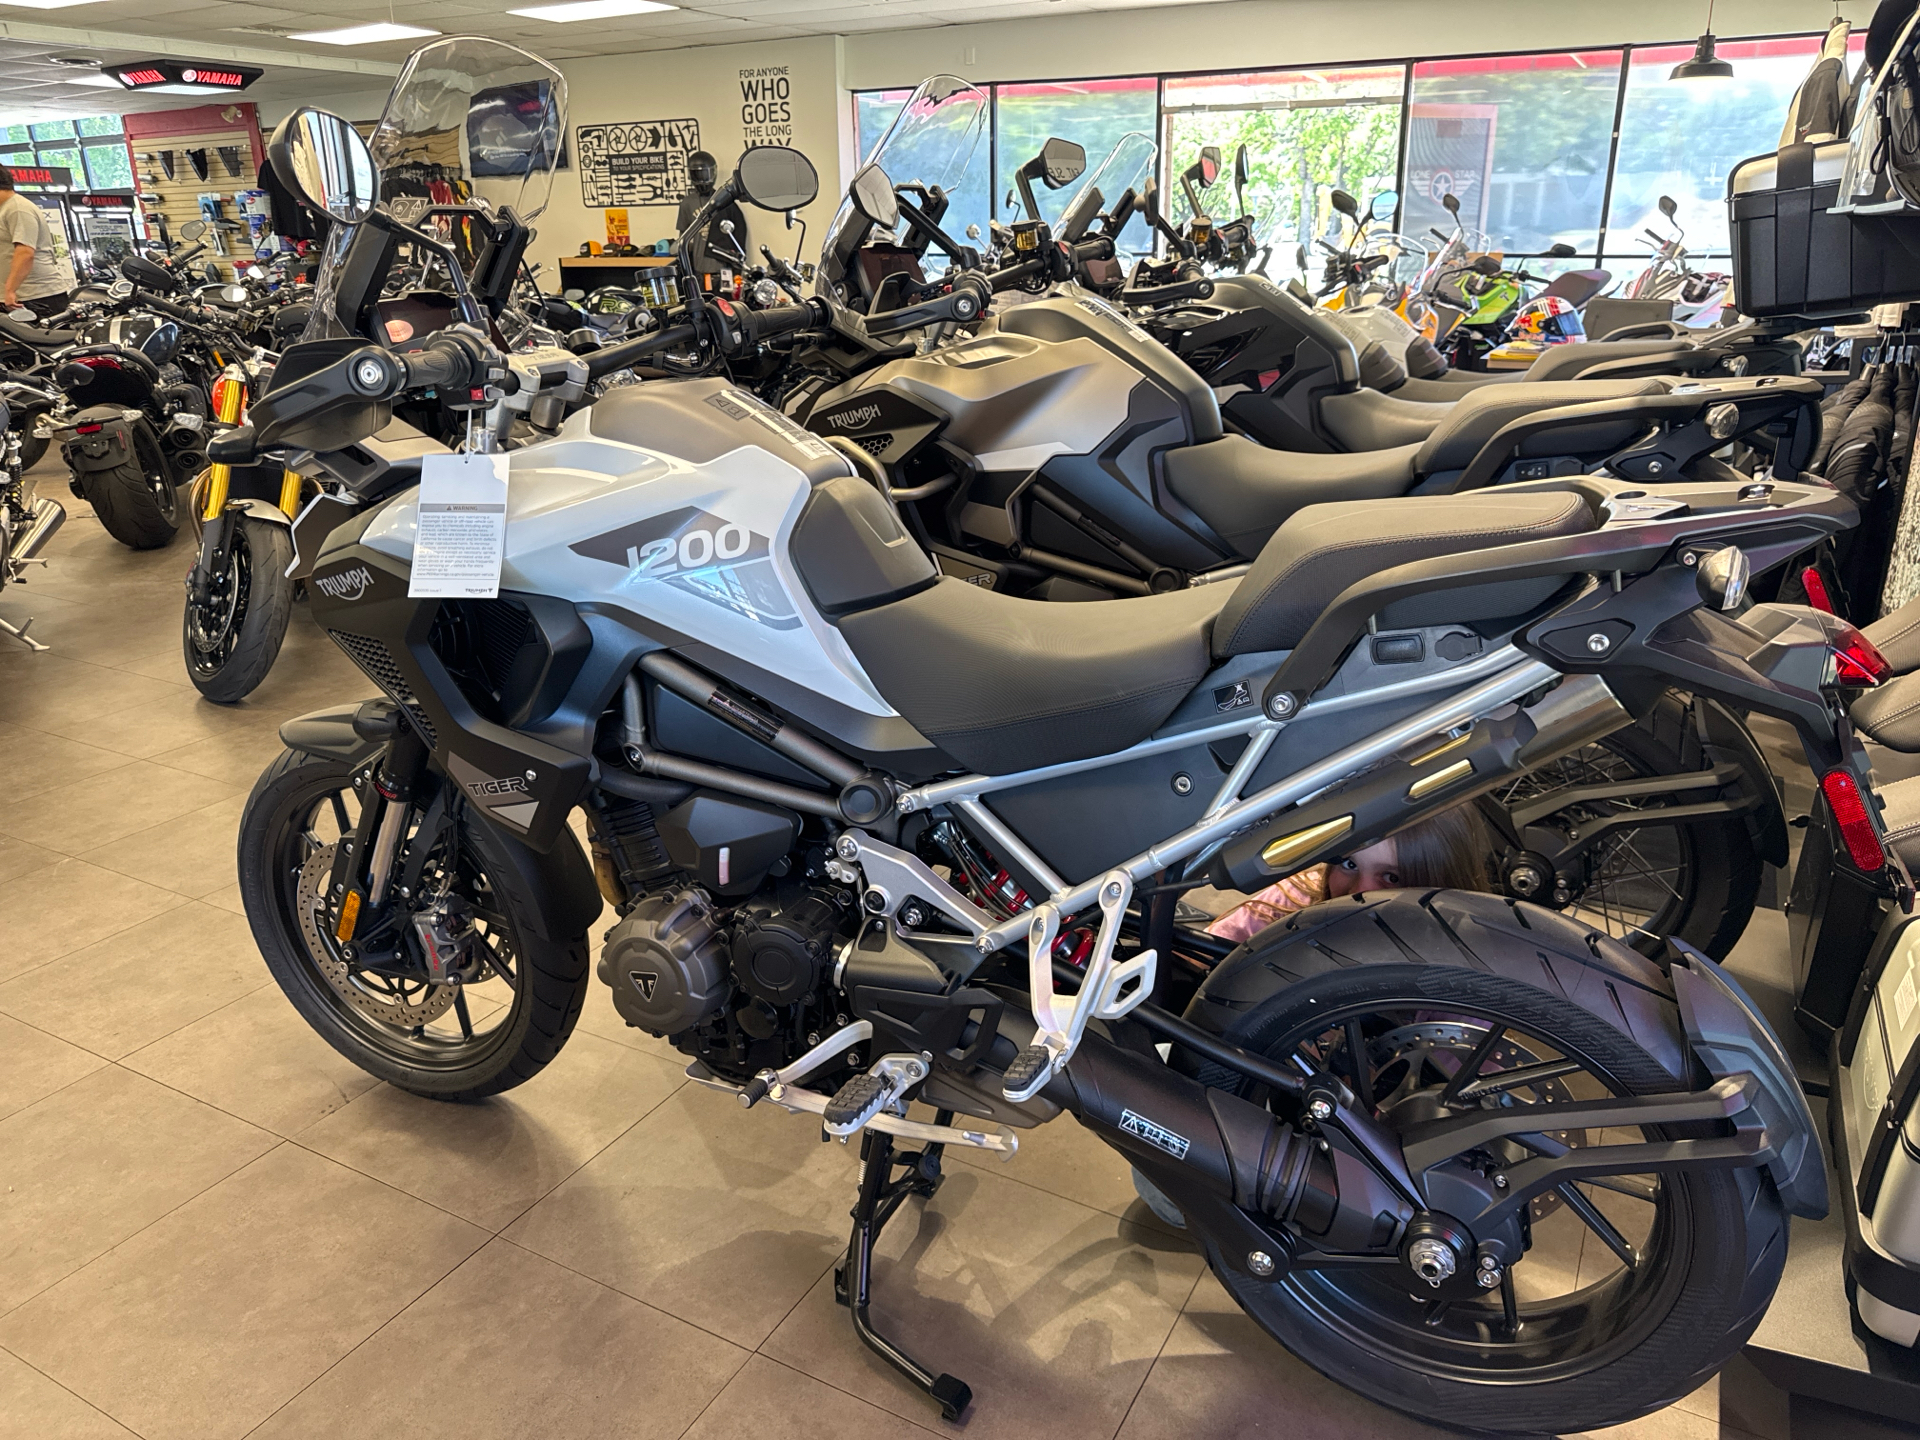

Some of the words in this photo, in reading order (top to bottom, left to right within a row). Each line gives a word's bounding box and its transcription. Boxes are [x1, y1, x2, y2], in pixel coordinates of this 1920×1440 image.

[197, 71, 243, 86] YAMAHA
[739, 69, 755, 79] FOR
[756, 66, 790, 78] ANYONE
[740, 77, 790, 102] WHO
[742, 101, 791, 125] GOES
[743, 126, 763, 138] THE
[765, 124, 792, 137] LONG
[611, 157, 630, 166] BUILD
[630, 156, 648, 165] YOUR
[649, 155, 664, 164] BIKE
[10, 169, 53, 183] AMAHA
[1410, 170, 1431, 179] LONE
[1455, 170, 1476, 179] STAR
[90, 196, 123, 206] YAMAHA
[827, 404, 881, 430] TRIUMPH
[626, 523, 751, 579] 1200
[315, 566, 375, 601] TRIUMPH
[467, 776, 530, 797] TIGER
